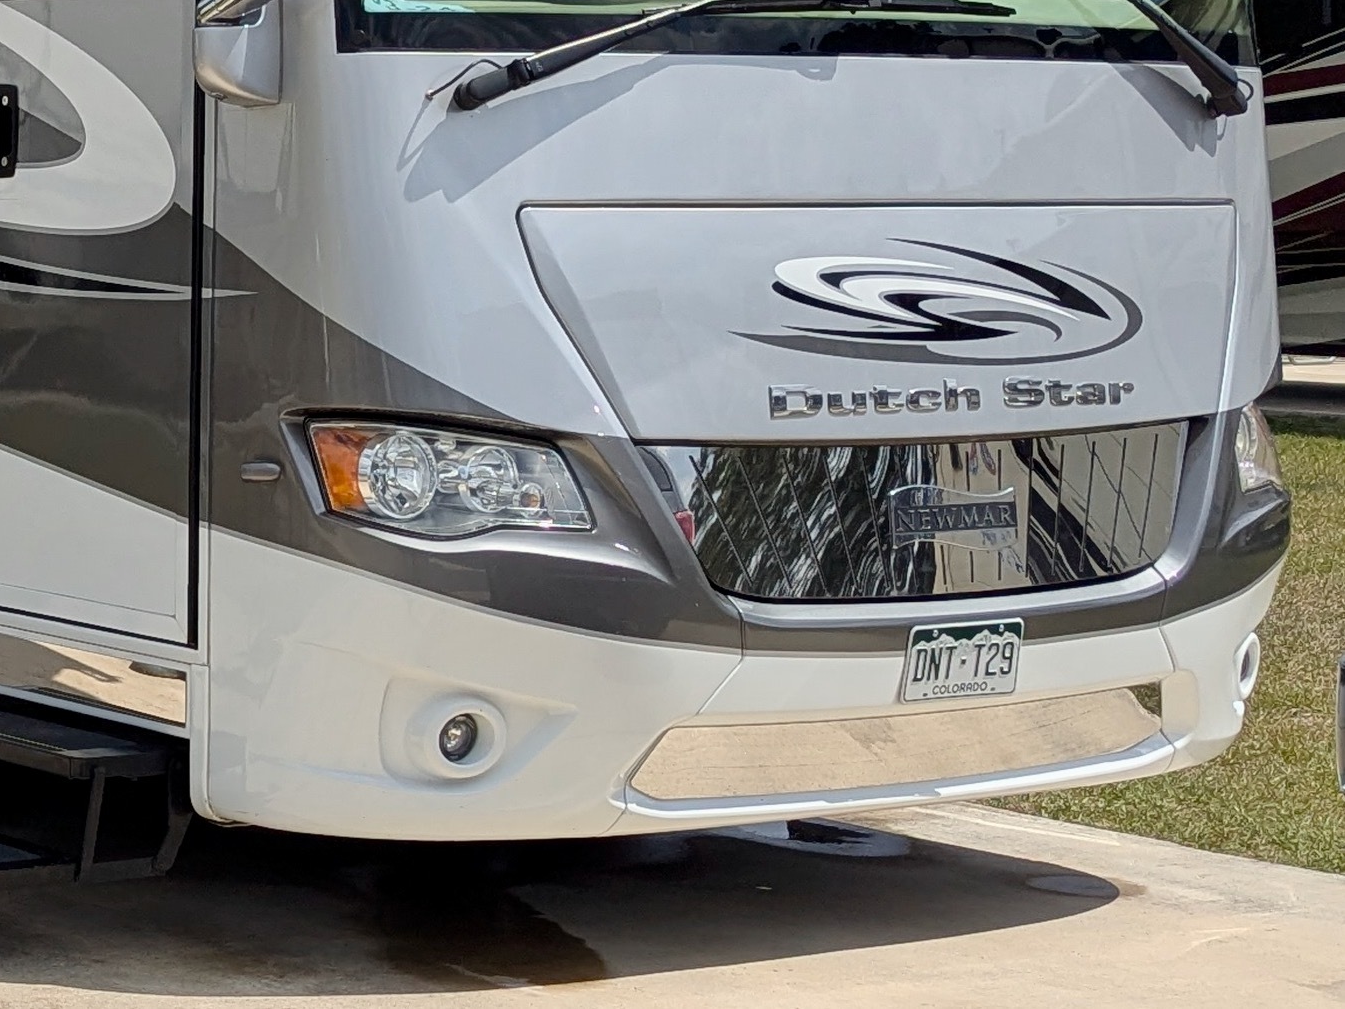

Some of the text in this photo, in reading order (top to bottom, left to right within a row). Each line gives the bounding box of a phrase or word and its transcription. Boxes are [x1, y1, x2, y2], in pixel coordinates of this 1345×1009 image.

[768, 375, 1135, 421] Dutch Star
[896, 504, 1016, 531] NEWMAR
[932, 680, 989, 696] COLORADO
